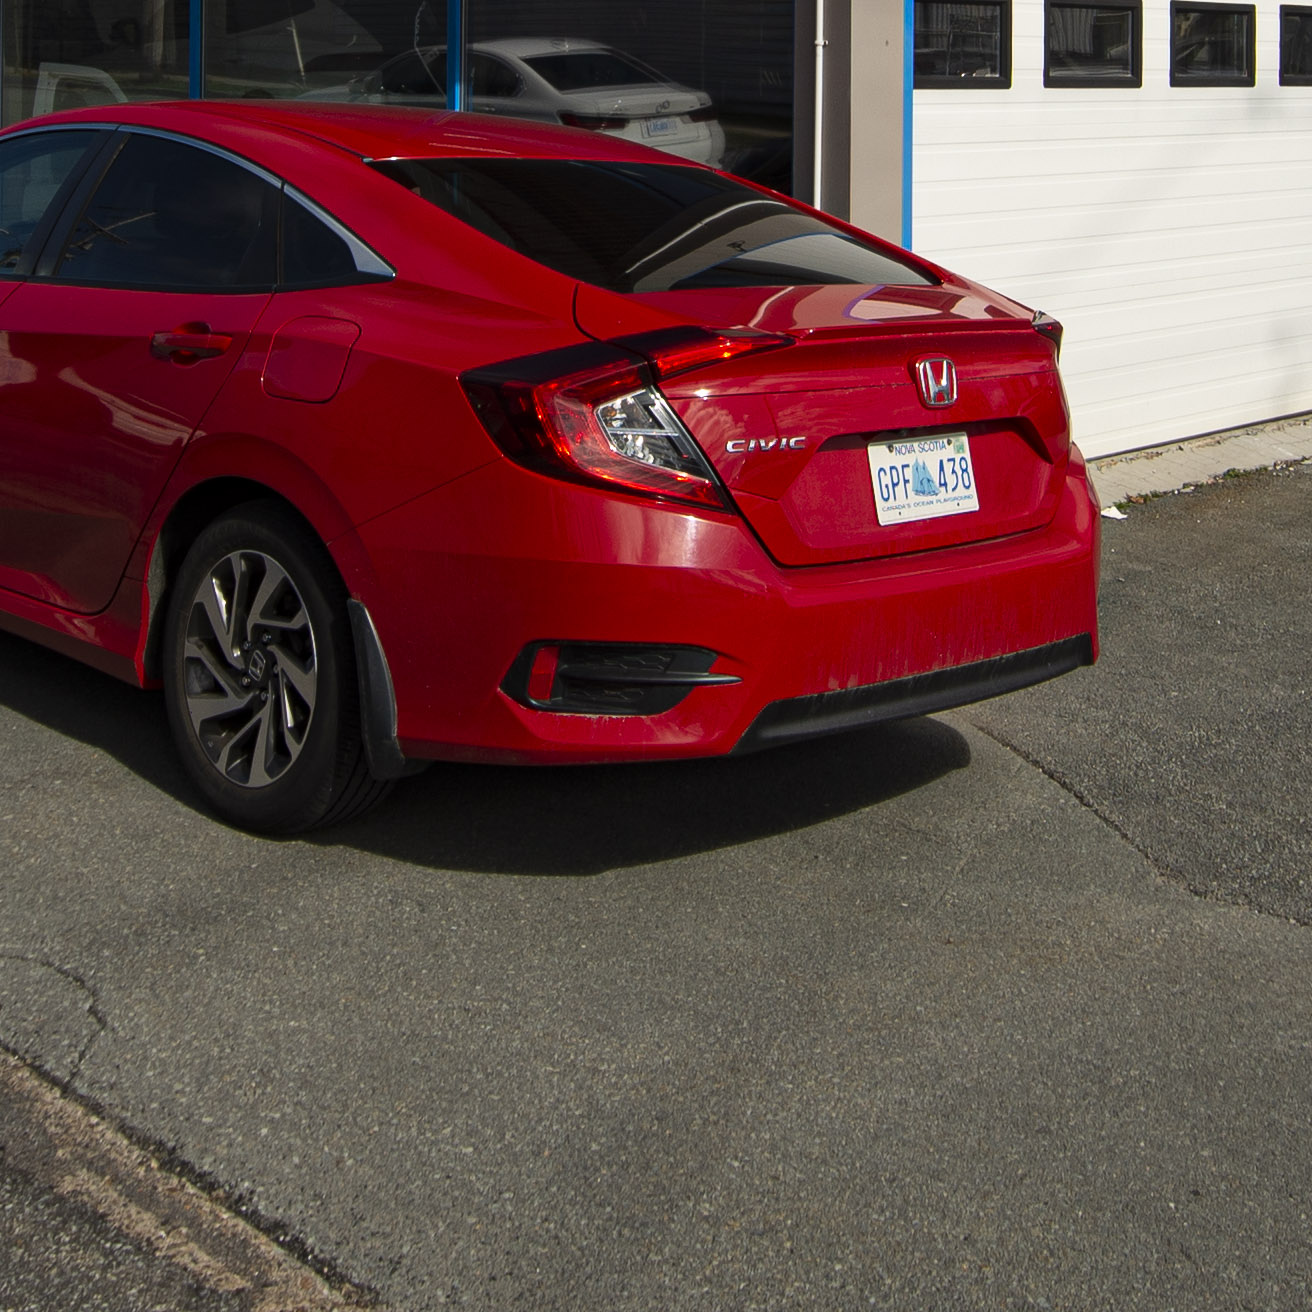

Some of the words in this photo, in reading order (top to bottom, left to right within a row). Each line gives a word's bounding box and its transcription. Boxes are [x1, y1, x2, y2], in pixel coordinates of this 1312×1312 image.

[725, 436, 807, 453] CIVIC
[894, 443, 916, 456] NOVA
[917, 439, 947, 454] SCOTIA
[877, 463, 911, 503] GPF
[937, 455, 972, 494] 438
